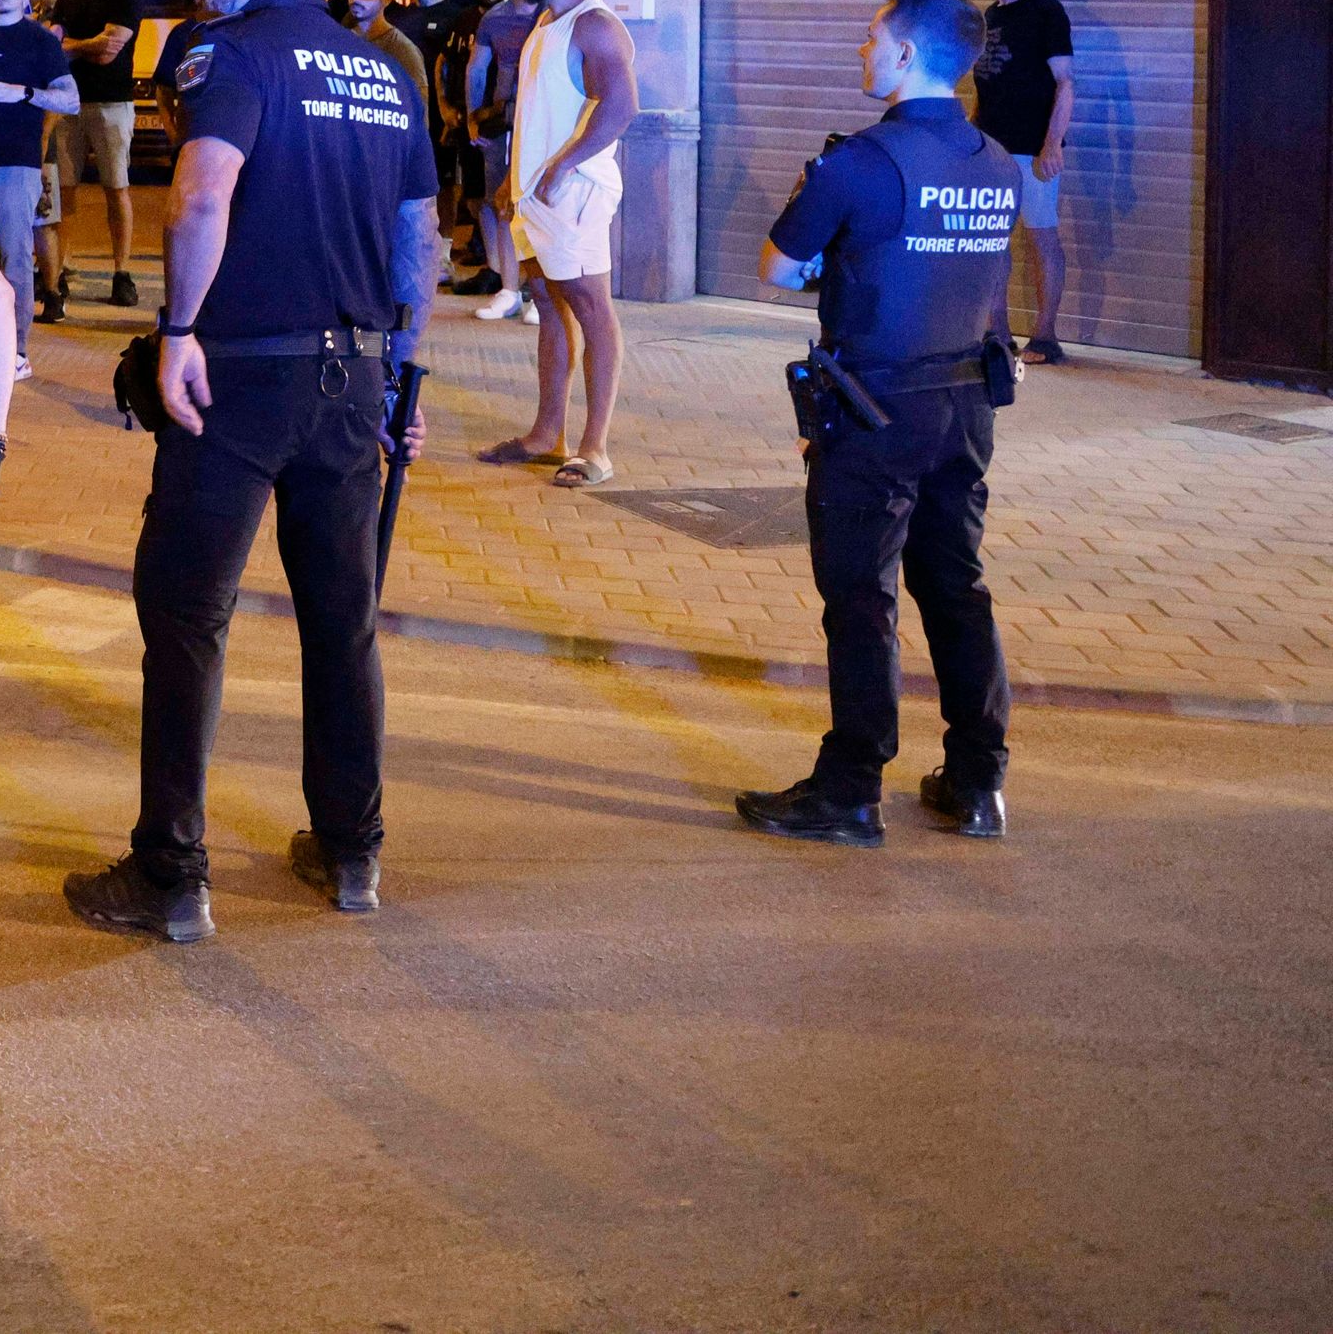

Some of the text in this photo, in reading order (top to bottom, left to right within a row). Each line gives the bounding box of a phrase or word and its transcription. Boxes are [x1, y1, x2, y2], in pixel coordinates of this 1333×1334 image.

[293, 48, 397, 84] POLICIA
[349, 81, 402, 105] LOCAL
[301, 99, 409, 130] TORRE PACHECO
[920, 186, 1015, 209] POLICIA
[968, 214, 1011, 231] LOCAL
[905, 236, 1010, 253] TORRE PACHECO
